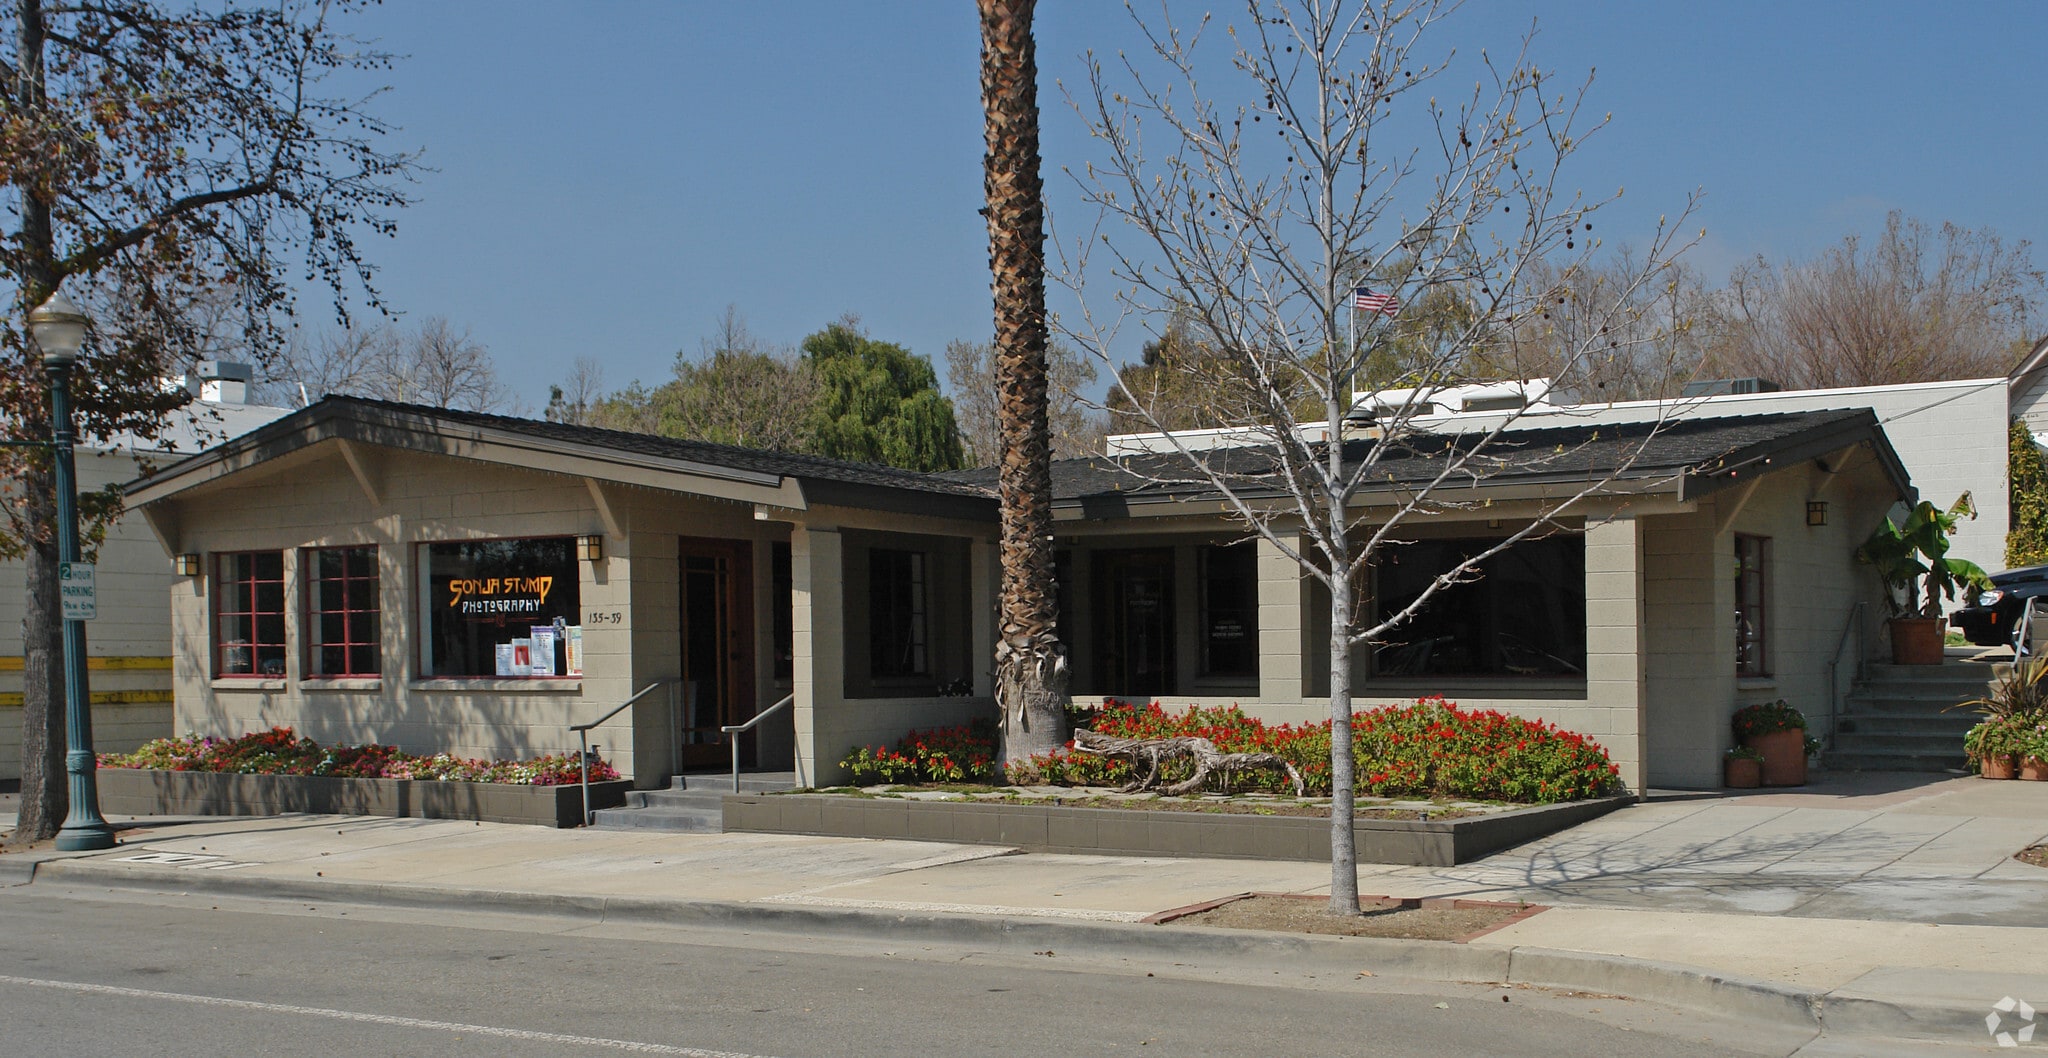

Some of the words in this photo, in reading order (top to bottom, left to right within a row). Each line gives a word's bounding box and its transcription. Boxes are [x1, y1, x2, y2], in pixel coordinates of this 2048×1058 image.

[61, 566, 70, 580] 2
[73, 570, 91, 580] HOUR
[63, 586, 93, 596] PARKING
[450, 579, 500, 607] SONJA
[462, 600, 540, 613] PHOTOGRAPHY
[589, 612, 622, 624] 135-39
